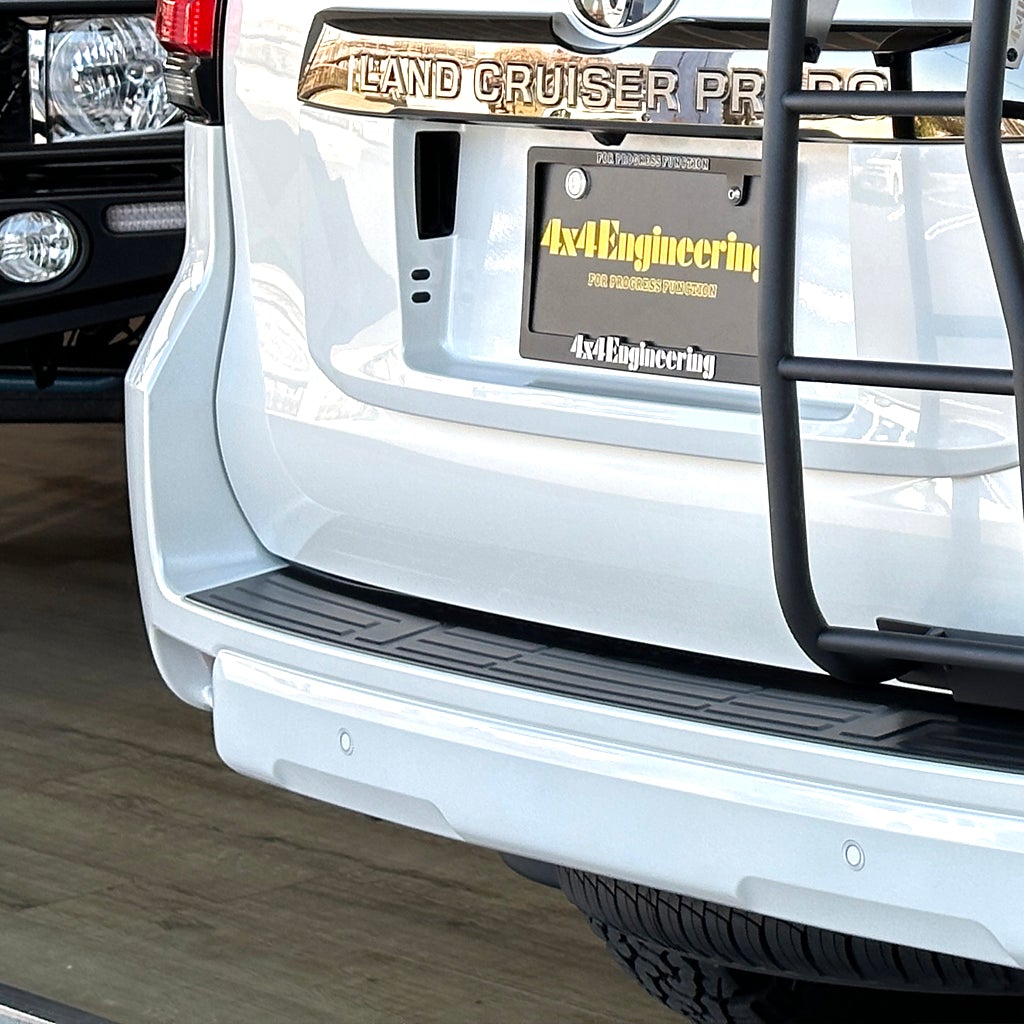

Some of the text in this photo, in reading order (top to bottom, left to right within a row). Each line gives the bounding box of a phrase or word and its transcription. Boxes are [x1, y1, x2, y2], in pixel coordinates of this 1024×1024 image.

[359, 53, 462, 99] LAND
[473, 57, 680, 113] CRUISER
[596, 152, 710, 171] FOR PROGRESS FUNCTION
[587, 272, 718, 299] FOR PROGRESS FUNCTION
[570, 333, 717, 380] 4x4Engineering
